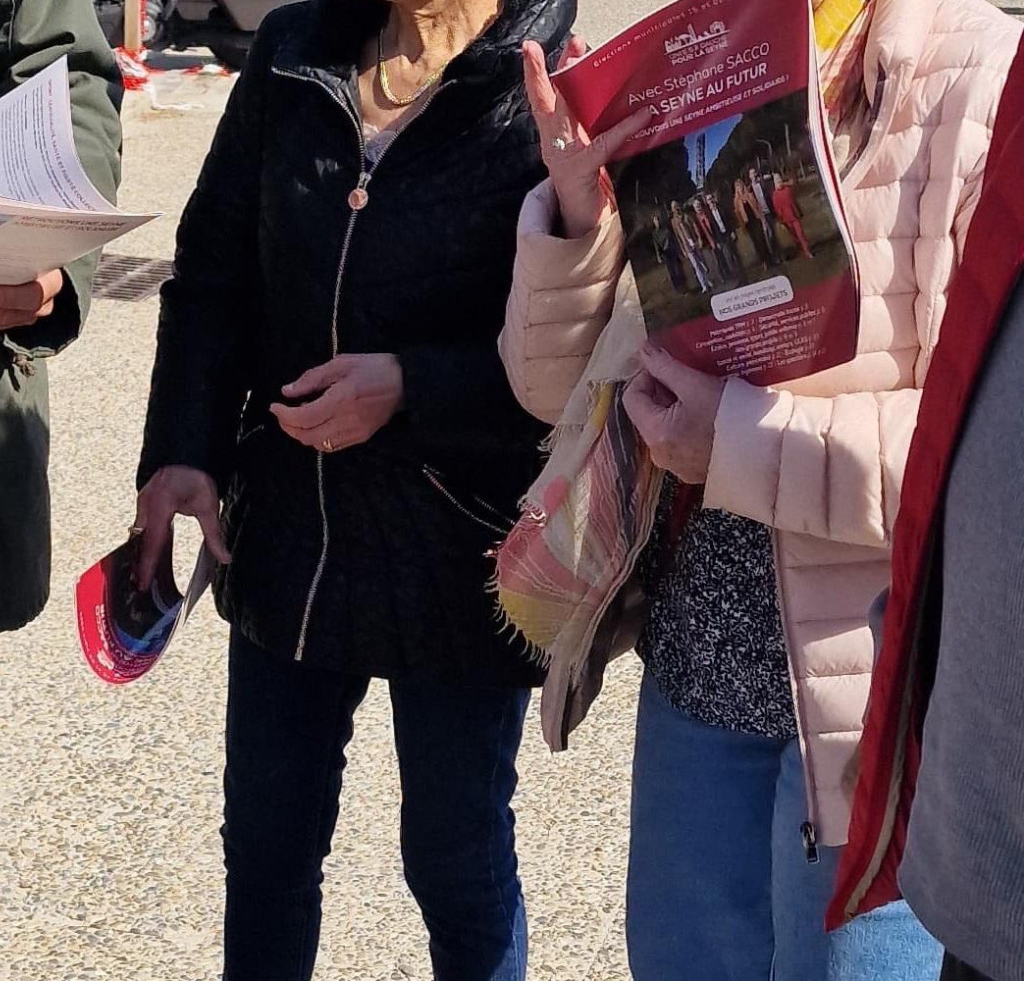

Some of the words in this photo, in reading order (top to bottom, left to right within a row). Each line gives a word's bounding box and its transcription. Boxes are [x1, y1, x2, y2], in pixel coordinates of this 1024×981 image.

[628, 85, 663, 106] Avec
[726, 43, 769, 70] SACCO
[660, 91, 704, 113] SEYNE
[706, 81, 724, 97] AU
[726, 63, 767, 88] FUTUR
